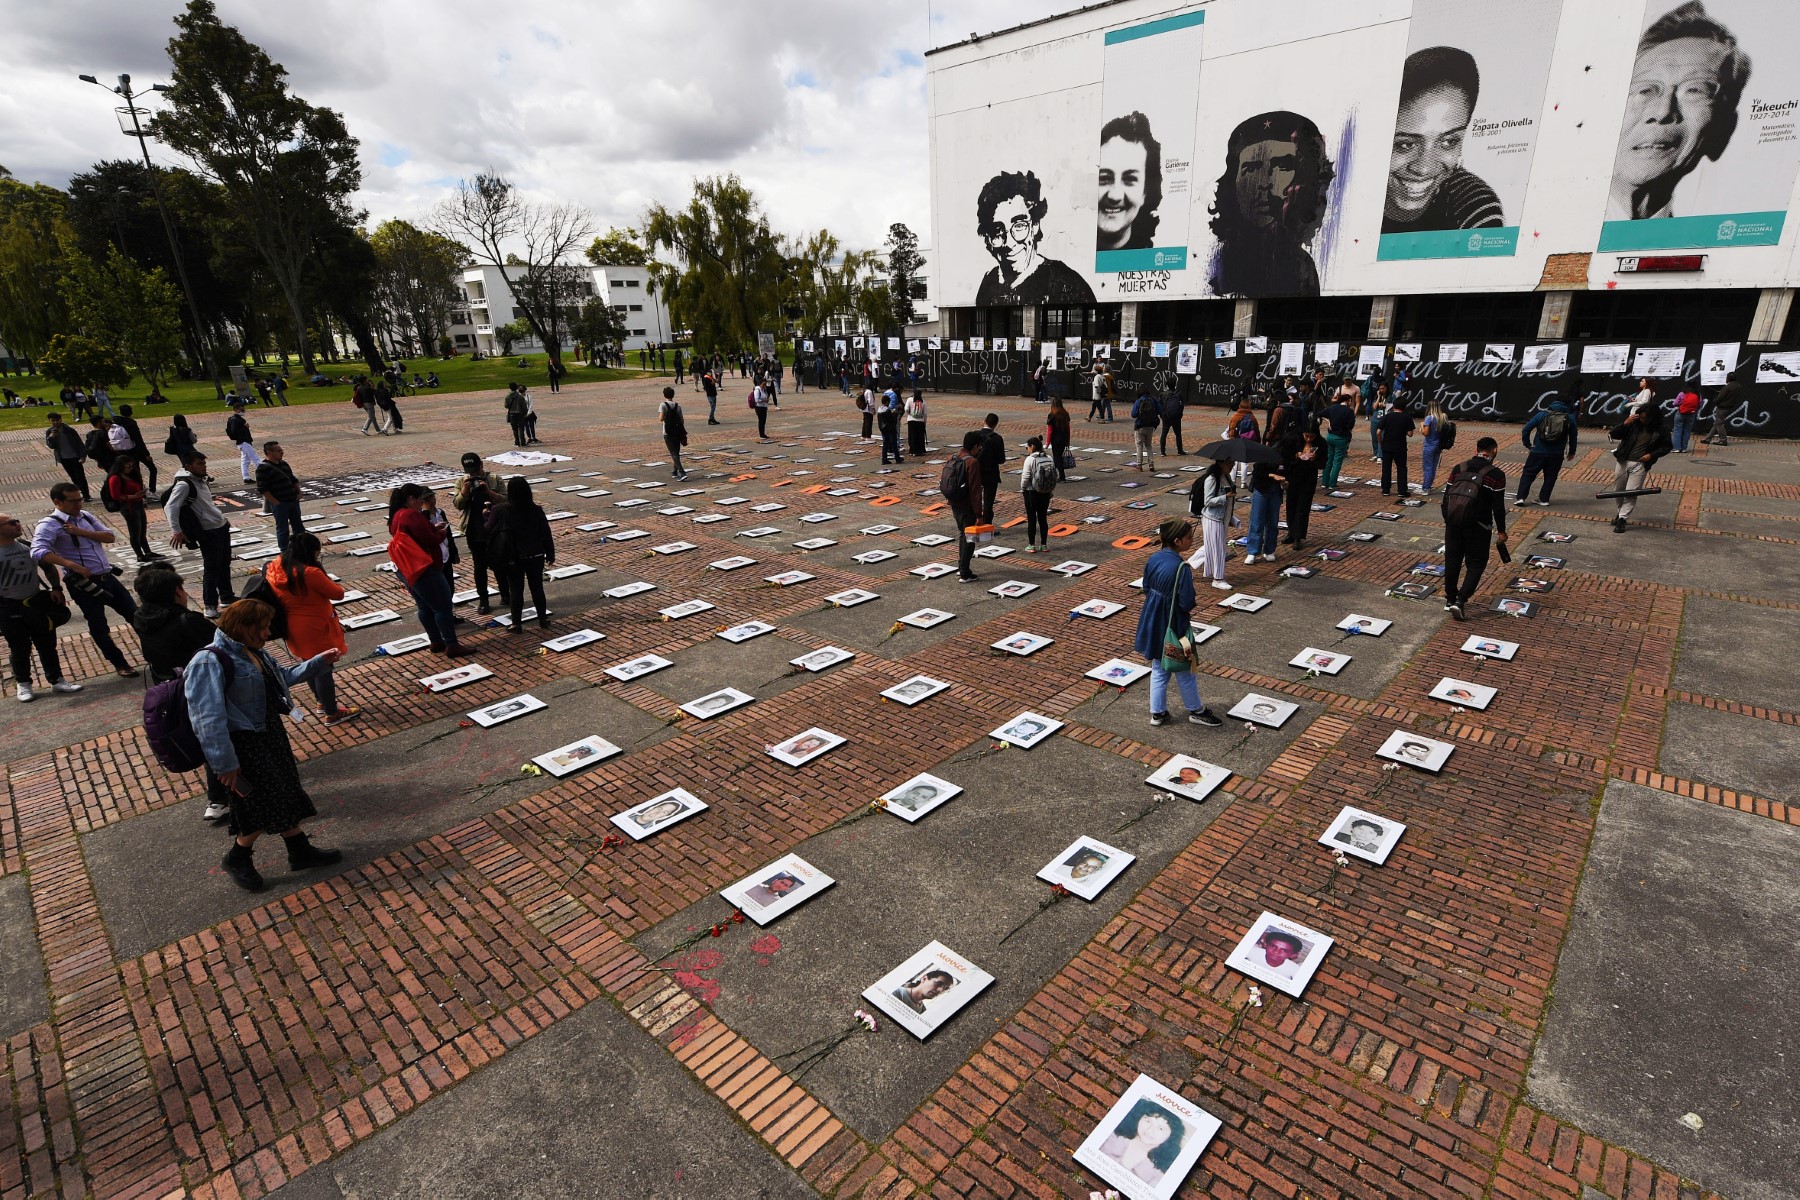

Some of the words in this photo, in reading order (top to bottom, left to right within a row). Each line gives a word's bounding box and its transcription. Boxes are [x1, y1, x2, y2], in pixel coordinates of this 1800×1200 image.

[1751, 99, 1799, 113] Takeuchi
[1749, 110, 1790, 121] 1927-2014
[1471, 123, 1500, 132] Zapata
[1501, 117, 1533, 128] Olivella
[1118, 279, 1167, 293] MUERTAS
